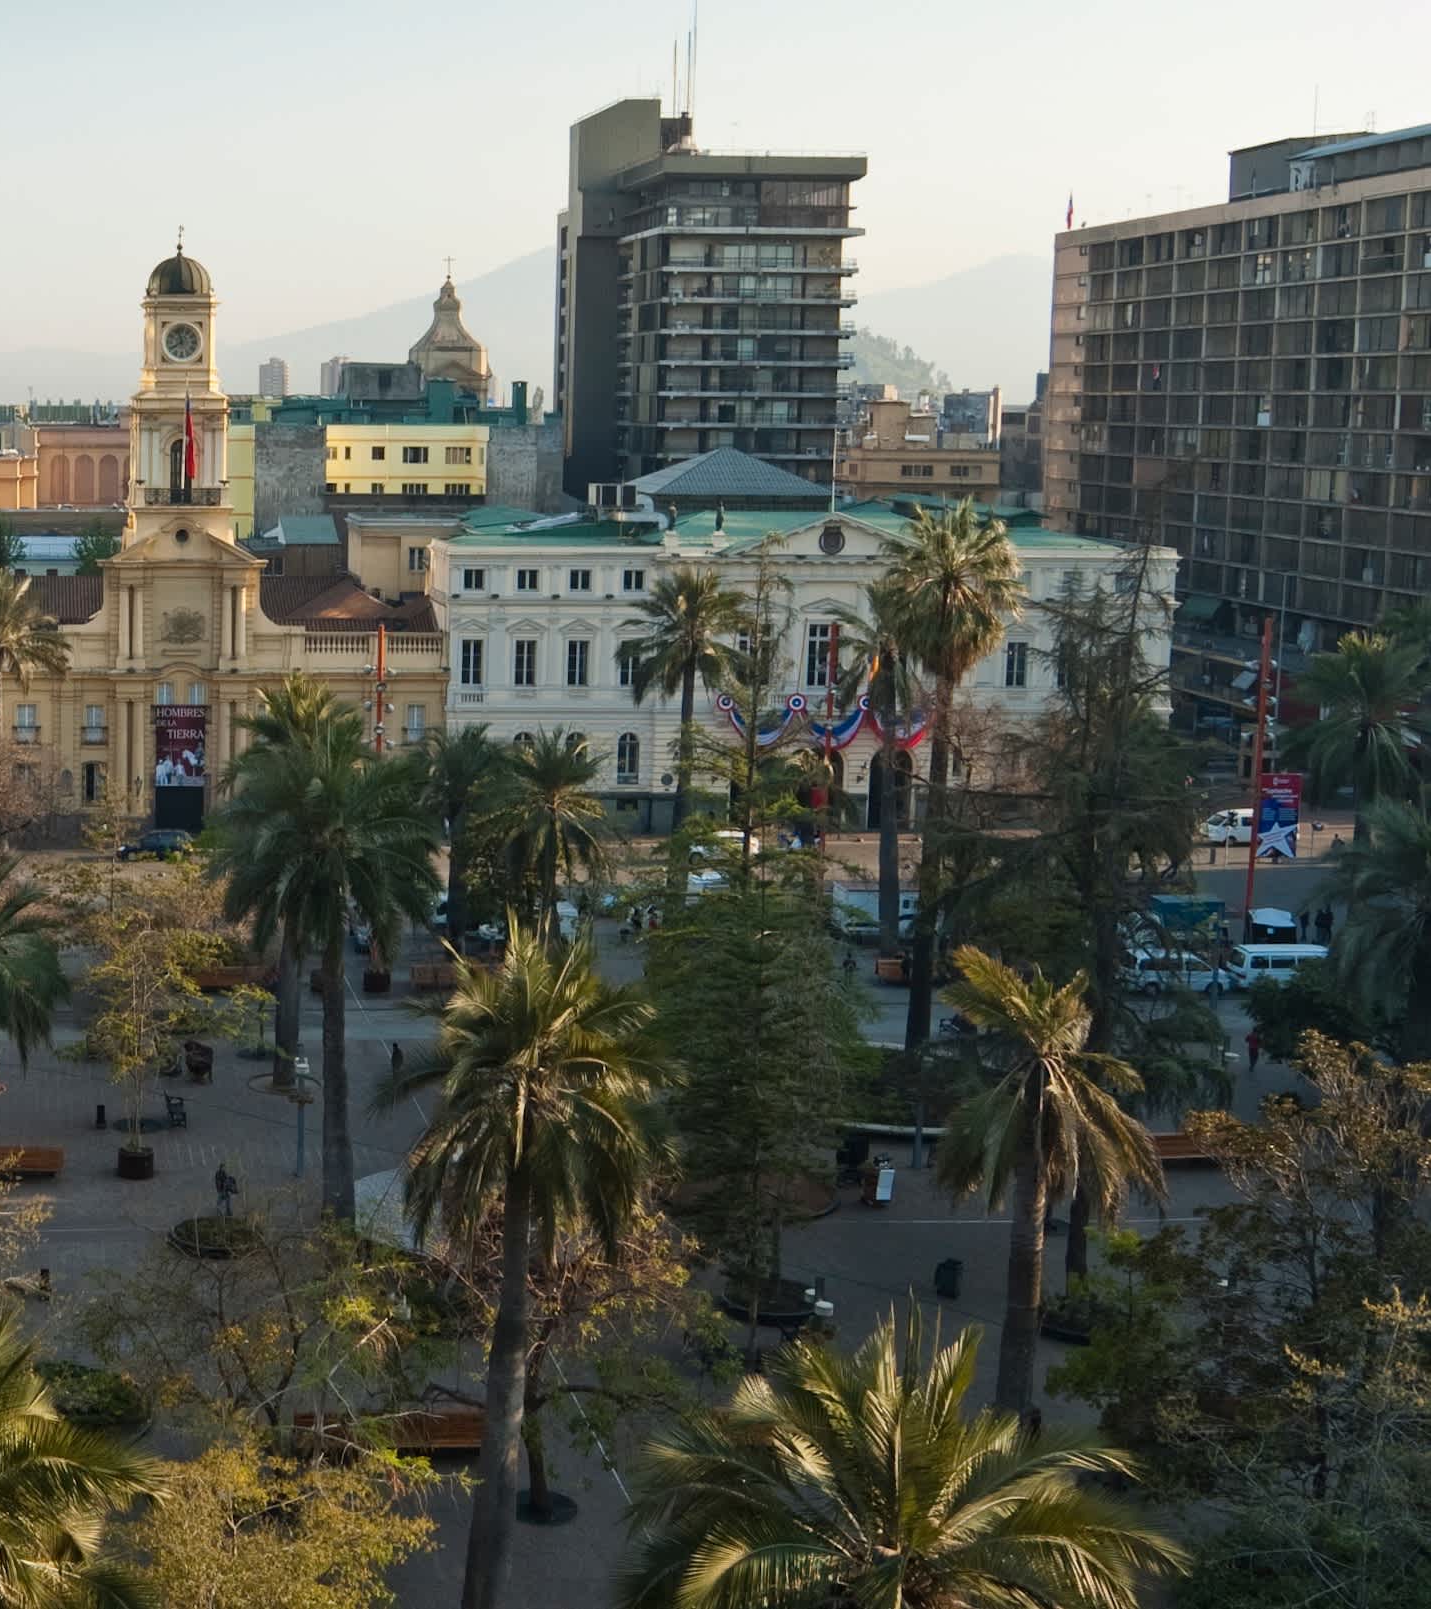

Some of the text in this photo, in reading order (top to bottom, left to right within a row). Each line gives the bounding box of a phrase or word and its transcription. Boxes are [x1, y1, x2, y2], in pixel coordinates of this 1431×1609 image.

[156, 707, 205, 718] HOMBRES
[168, 719, 177, 727] LA
[167, 728, 205, 740] TIERRA
